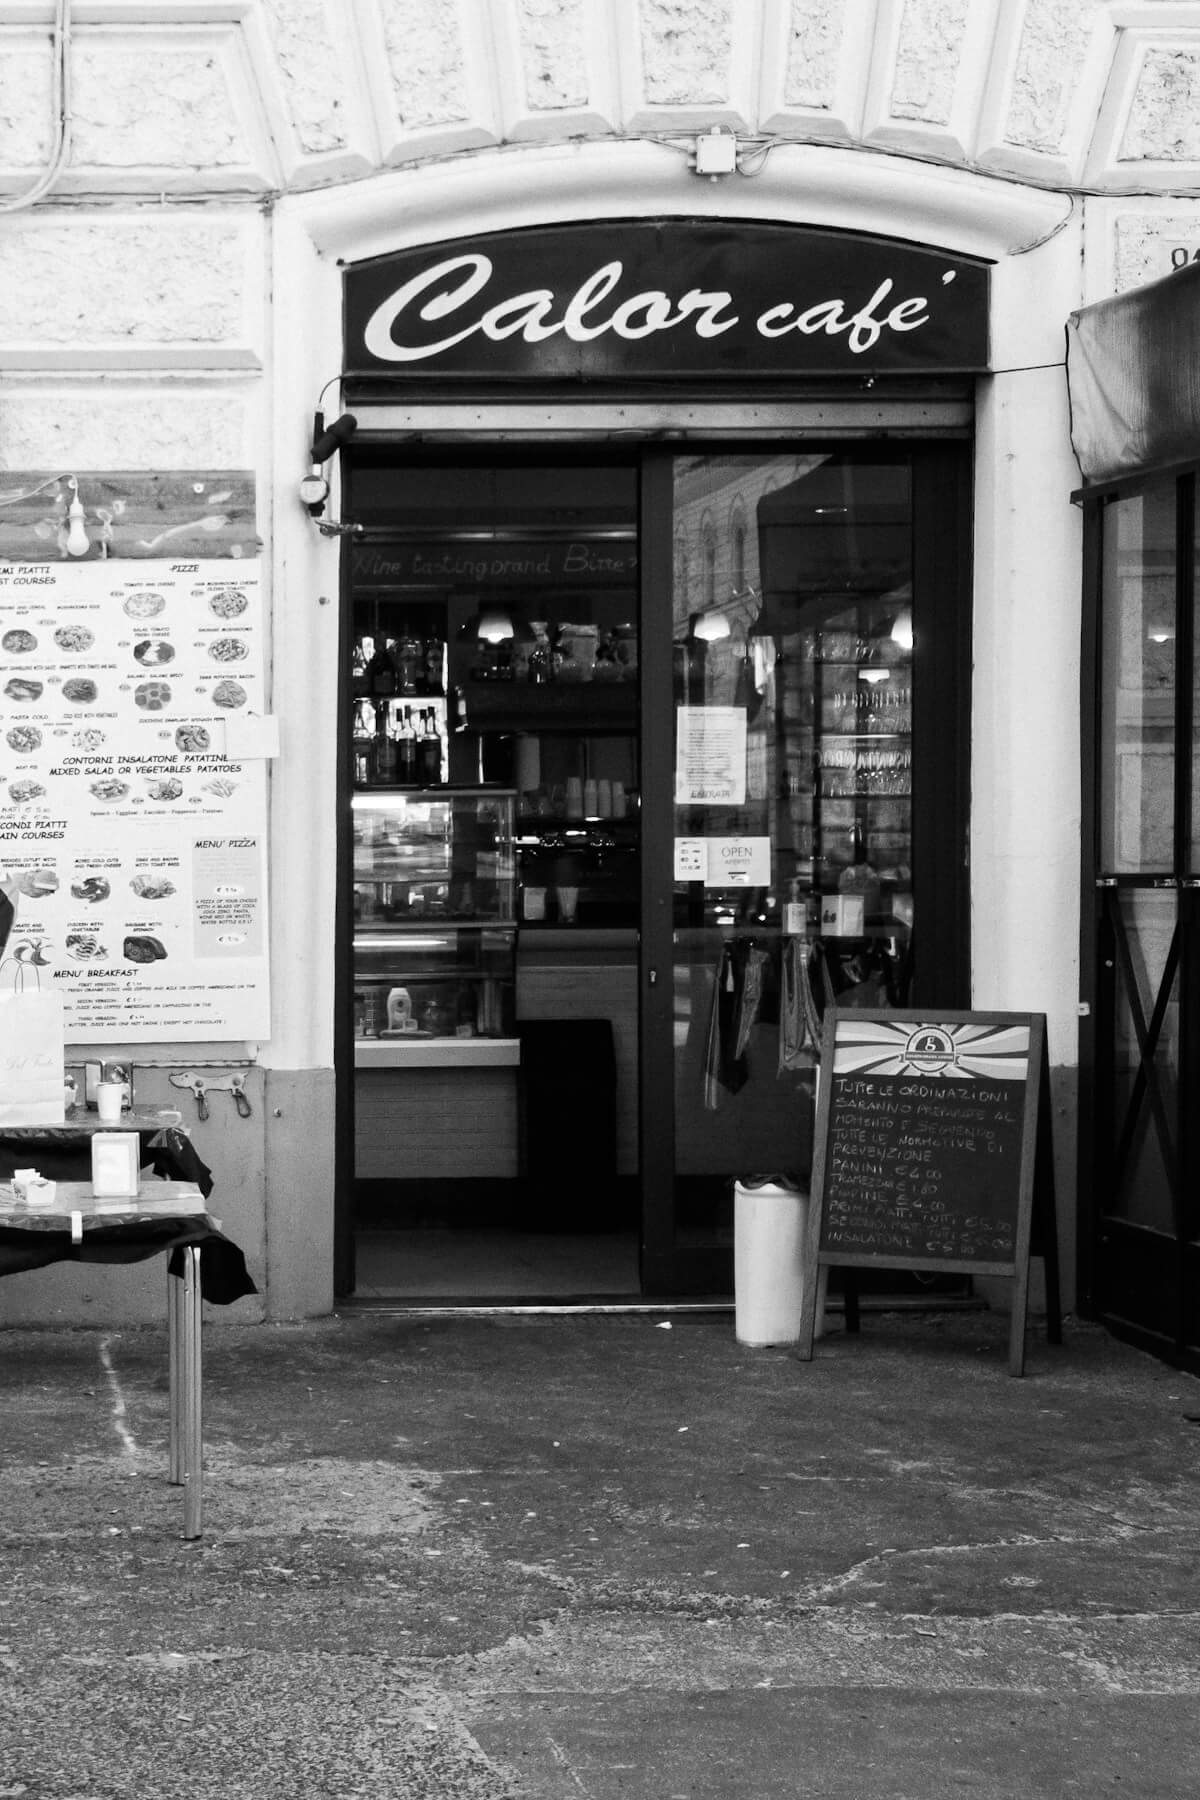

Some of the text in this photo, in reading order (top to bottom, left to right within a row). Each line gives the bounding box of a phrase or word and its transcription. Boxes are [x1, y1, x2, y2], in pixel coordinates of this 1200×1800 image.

[363, 253, 739, 361] Calor
[18, 565, 51, 575] PIATTI
[13, 576, 56, 585] COURSES
[63, 756, 112, 765] CONTORNI
[117, 755, 178, 764] INSALATONE
[49, 764, 242, 776] MIXED SALAD OR VEGETABLES PATATOES
[35, 820, 68, 829] PIATTI
[21, 831, 65, 840] COURSES
[228, 839, 256, 848] PIZZA
[720, 846, 753, 858] OPEN
[87, 968, 139, 977] BREAKFAST
[879, 1085, 894, 1096] LE
[832, 1158, 883, 1175] PANINI
